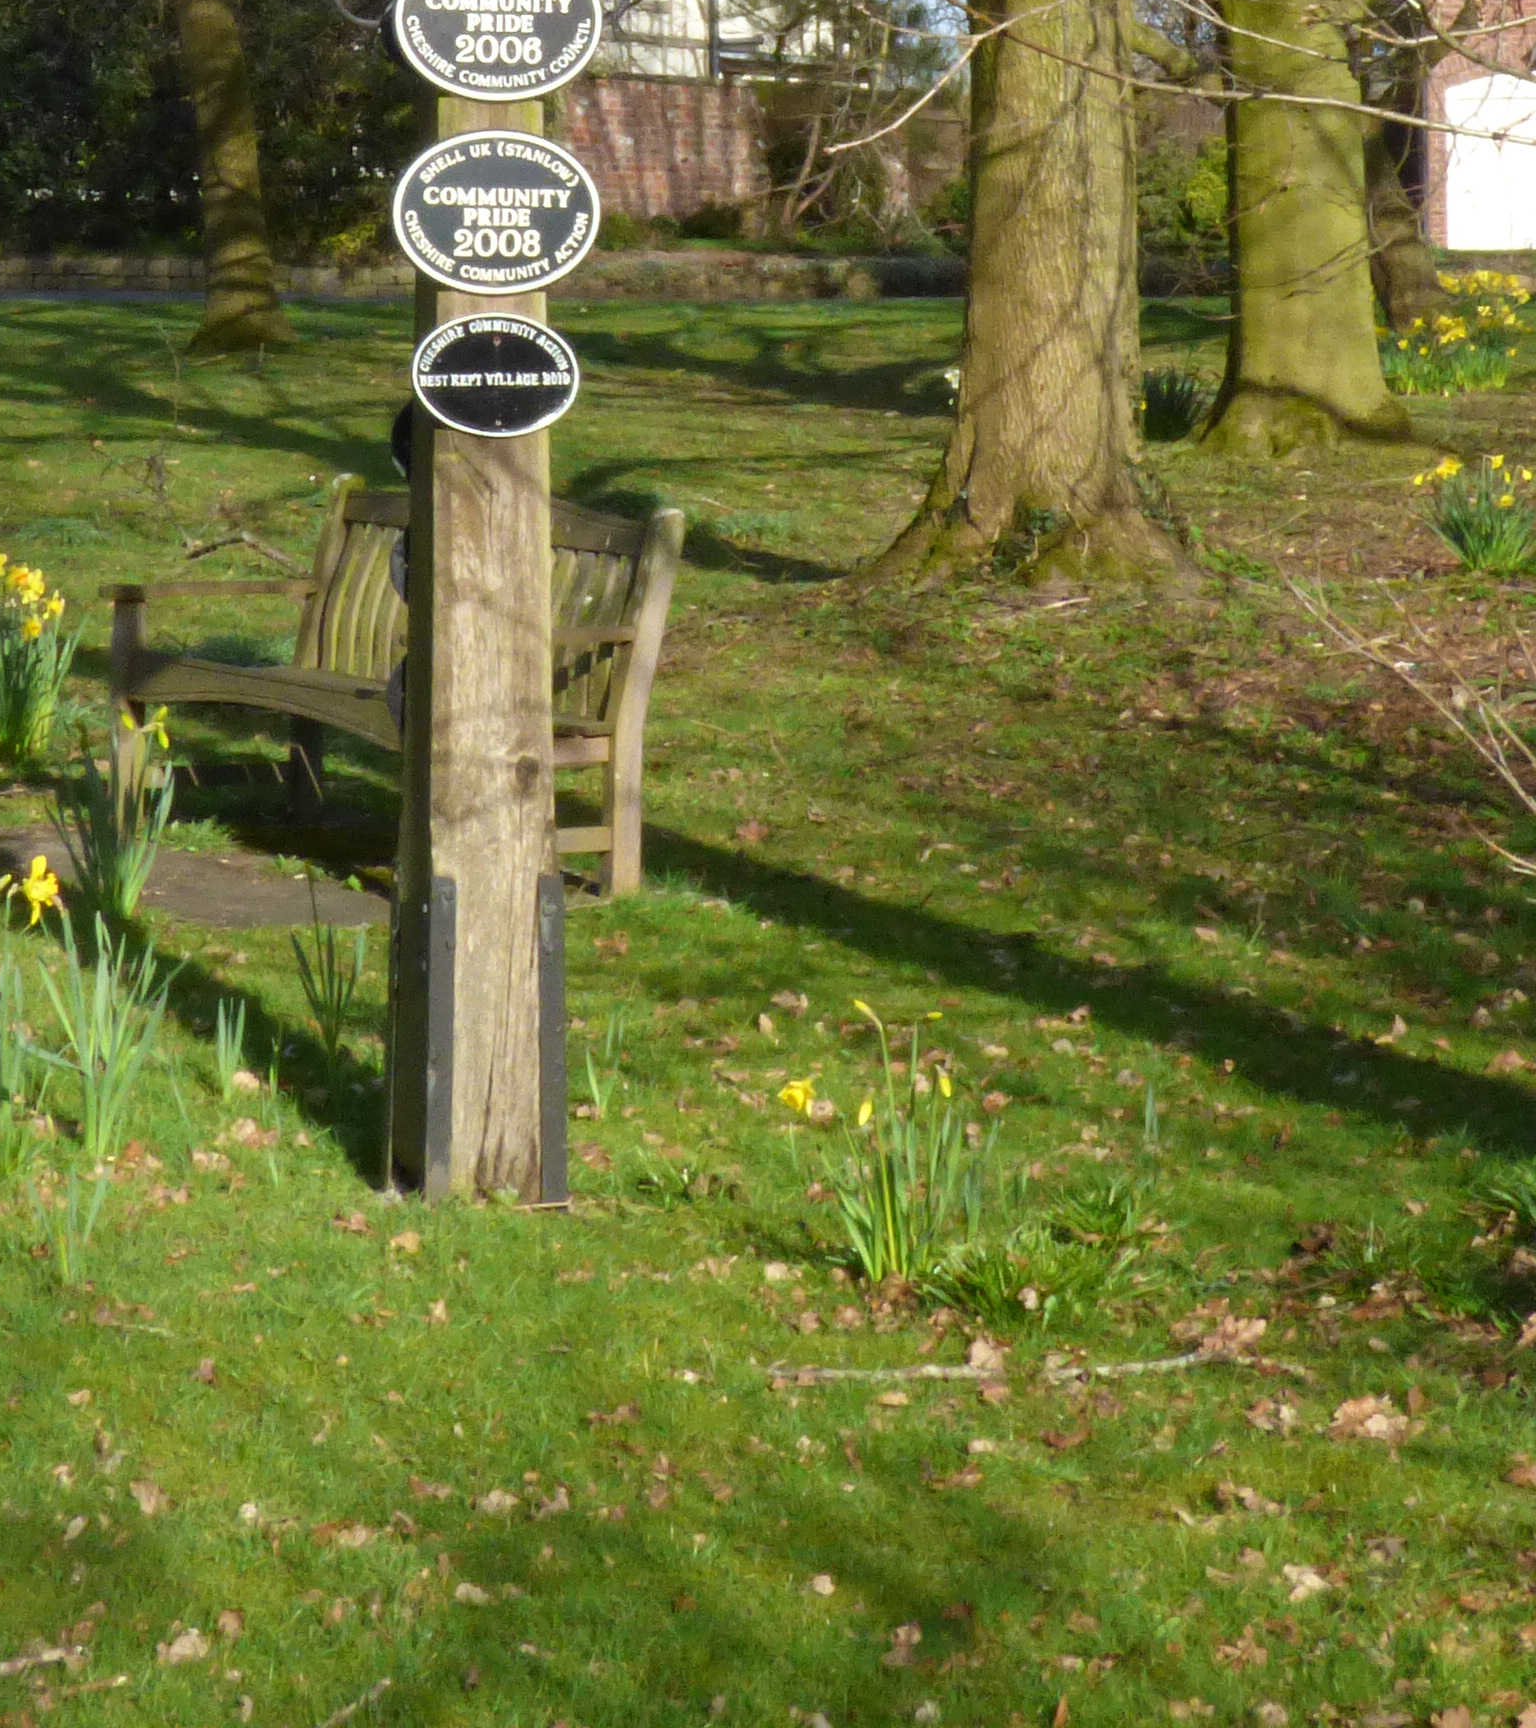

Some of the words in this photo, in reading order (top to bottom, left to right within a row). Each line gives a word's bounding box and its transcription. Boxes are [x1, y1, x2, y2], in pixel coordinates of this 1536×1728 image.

[466, 13, 534, 33] PRIDE
[406, 15, 457, 78] CHESHIRE
[459, 68, 546, 88] COMMUNITY
[549, 18, 591, 73] COUNCIL
[455, 35, 542, 65] 2006
[420, 149, 466, 184] SHELL
[469, 143, 492, 158] UK
[497, 141, 580, 188] (STANLOW)
[422, 186, 571, 208] COMMUNITY
[463, 208, 531, 227] PRIDE
[405, 210, 456, 272] CHESHIRE
[460, 258, 551, 282] COMMUNITY
[555, 212, 589, 264] ACTION
[453, 229, 541, 257] 2008
[419, 325, 465, 372] CHESHIRE
[469, 319, 537, 340] COMMUNITY
[536, 335, 569, 371] ACTION
[419, 374, 449, 387] BEST
[451, 372, 482, 386] KEPT
[485, 372, 539, 386] VILLAGE
